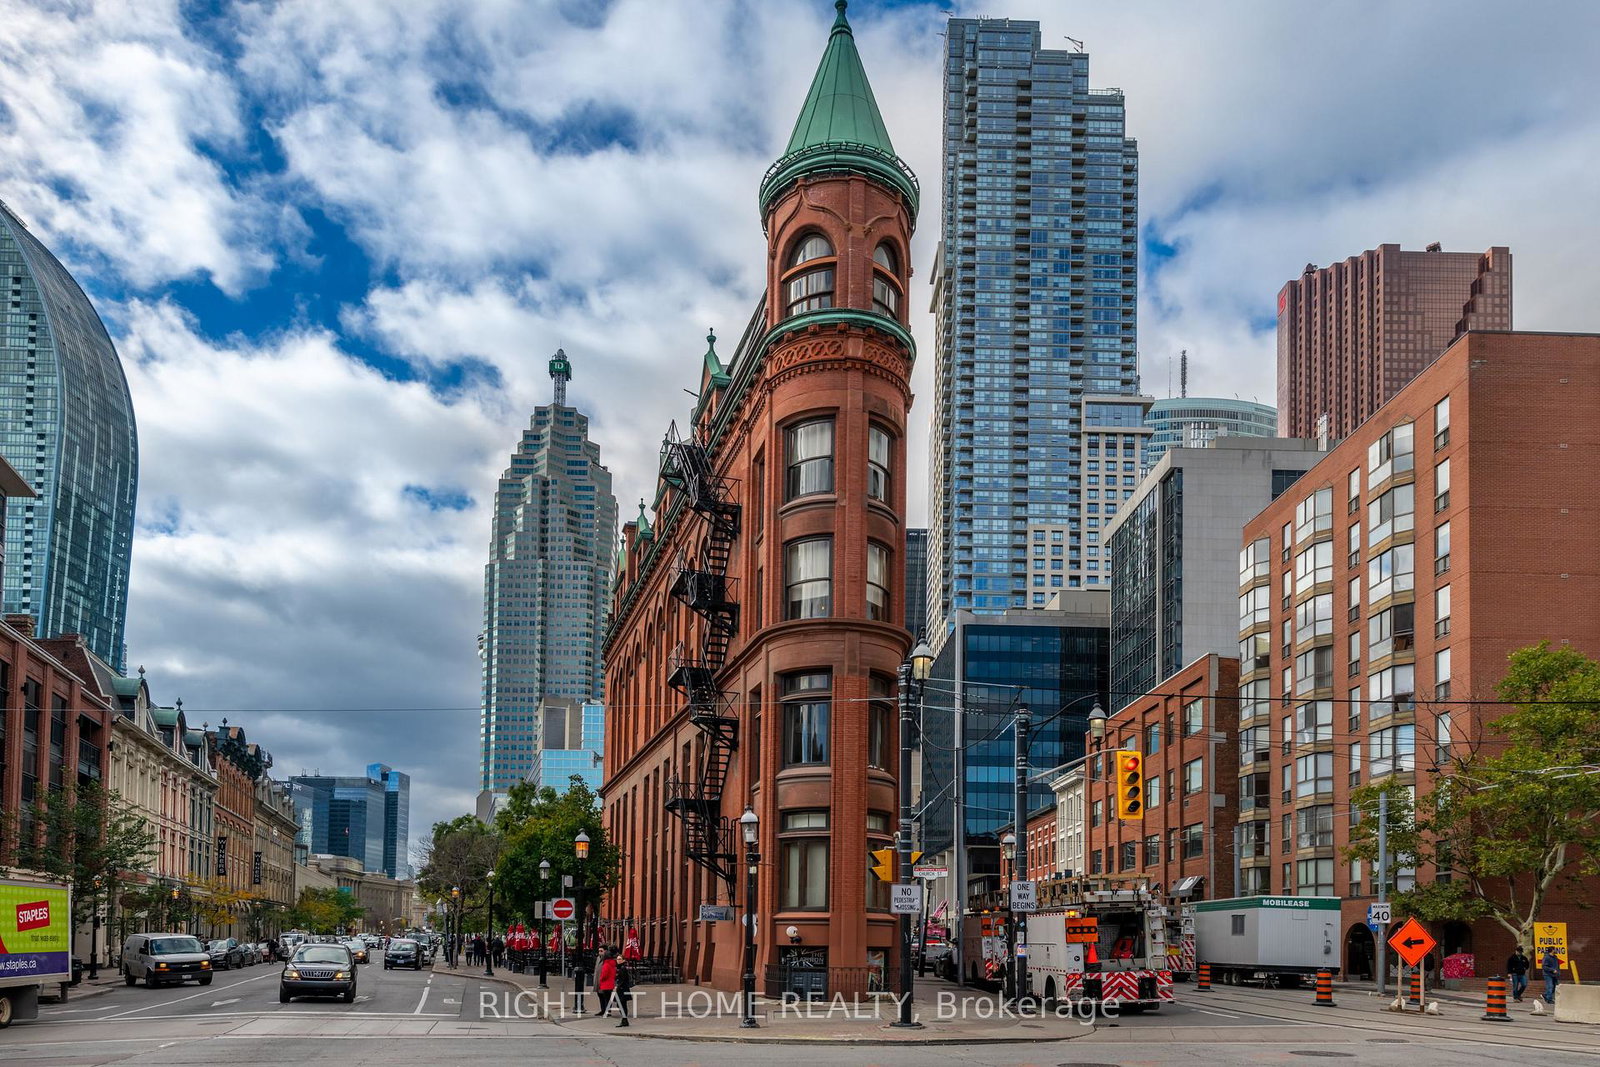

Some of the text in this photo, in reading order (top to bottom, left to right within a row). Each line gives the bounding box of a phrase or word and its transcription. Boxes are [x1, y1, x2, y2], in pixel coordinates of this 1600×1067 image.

[218, 839, 226, 874] WINNERS
[901, 887, 912, 896] NO
[1017, 883, 1030, 891] ONE
[1012, 901, 1035, 909] BEGINS
[1262, 899, 1310, 907] MOBILEASE
[18, 907, 48, 924] STAPLES
[1372, 911, 1390, 921] 40
[1539, 937, 1563, 945] PUBLIC
[1537, 946, 1566, 955] PARING
